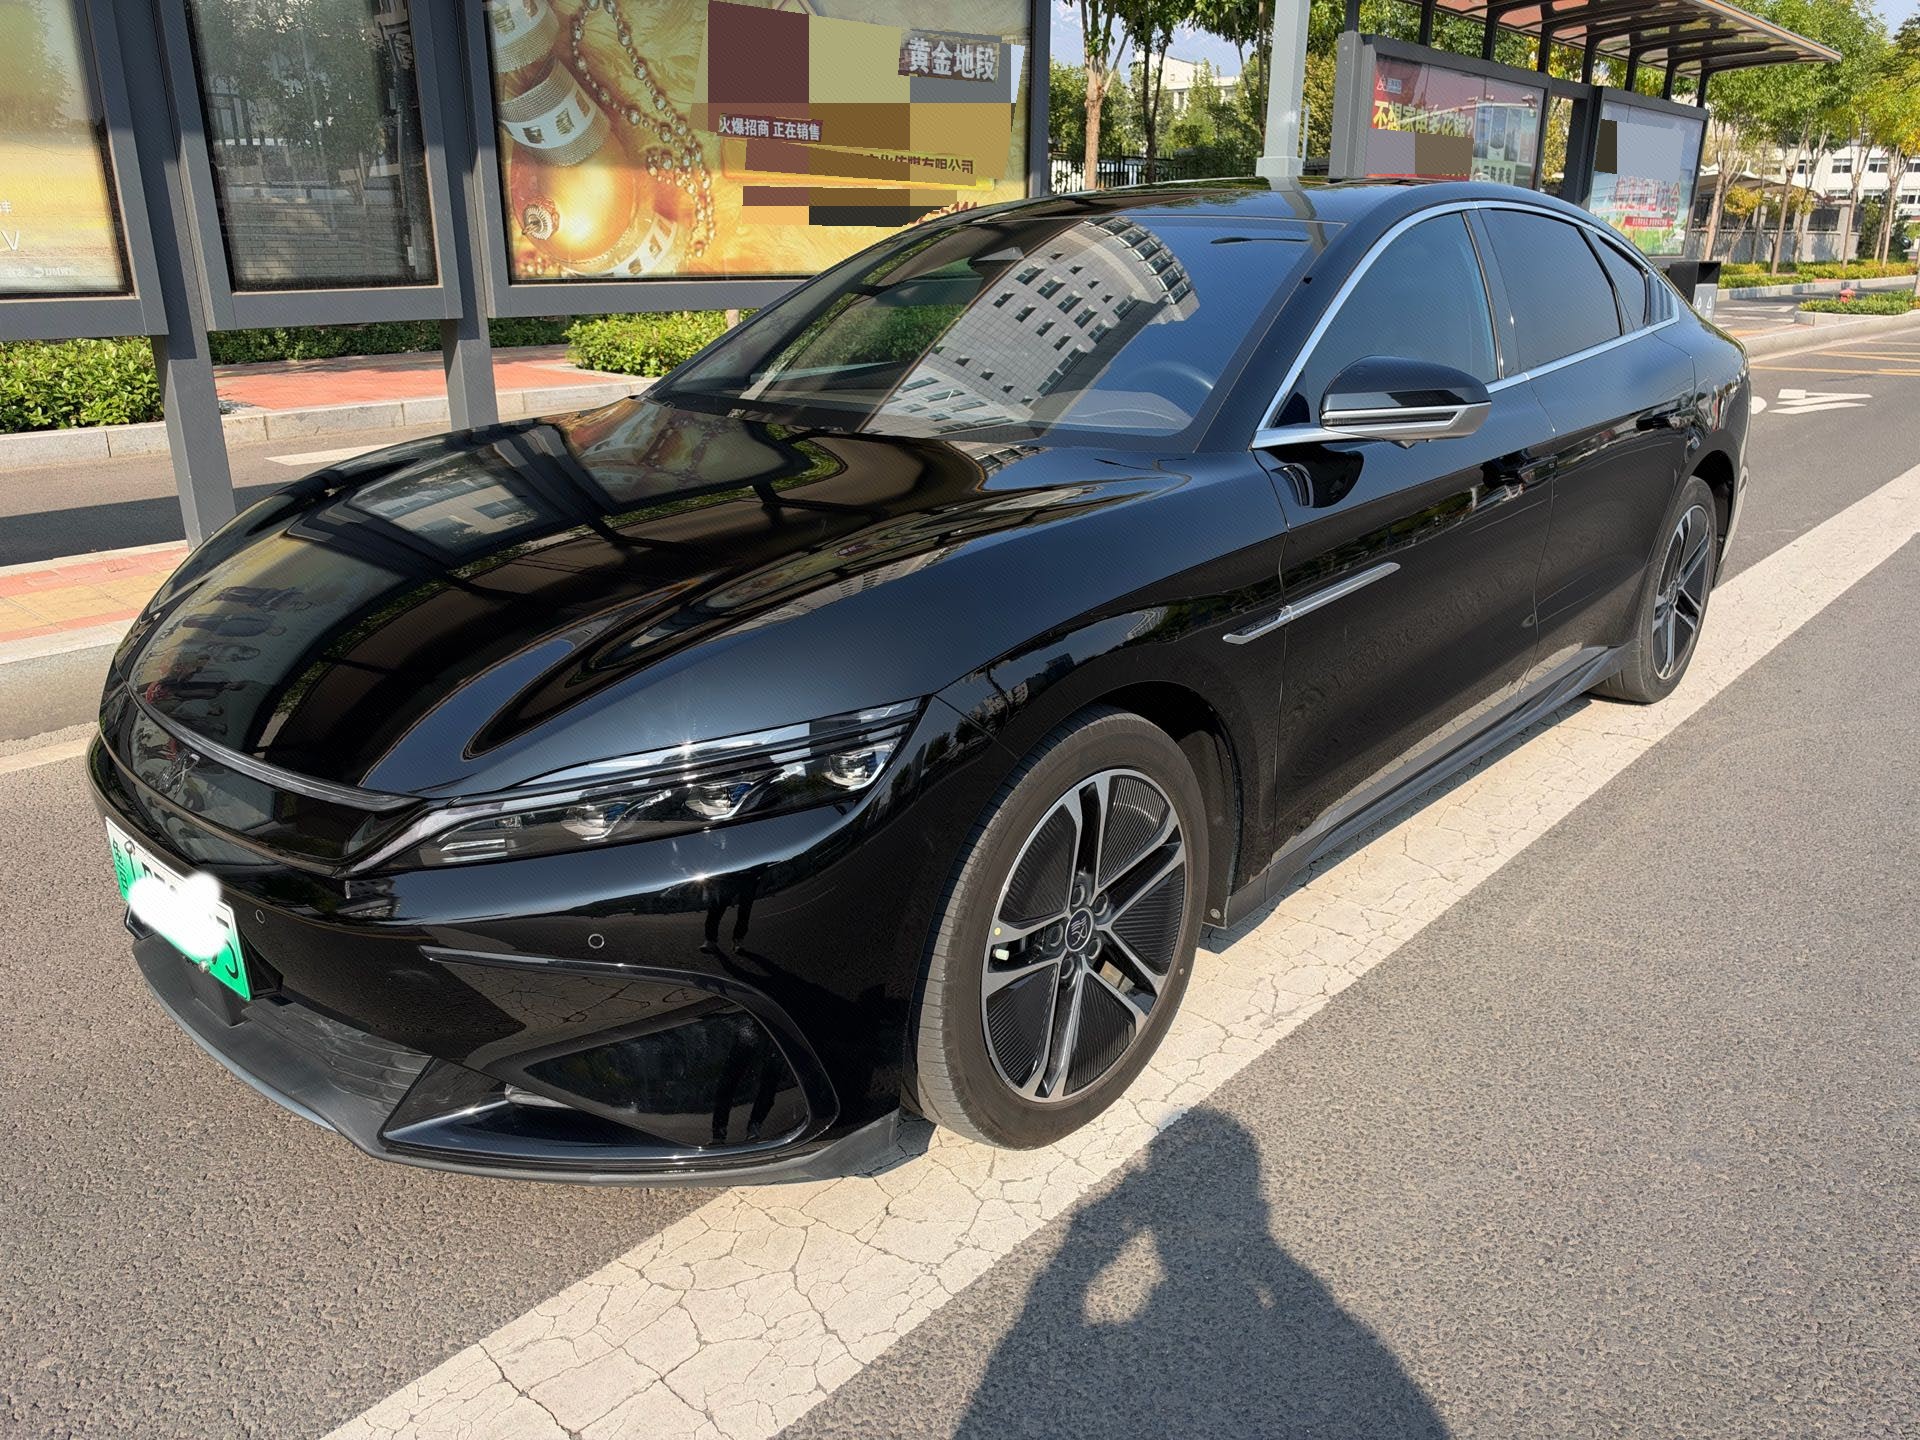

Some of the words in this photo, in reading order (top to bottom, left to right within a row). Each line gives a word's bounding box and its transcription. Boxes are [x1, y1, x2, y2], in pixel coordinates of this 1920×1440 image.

[908, 37, 996, 80] 黄金地段
[719, 117, 769, 137] 火爆招商
[773, 121, 820, 141] 正在销售
